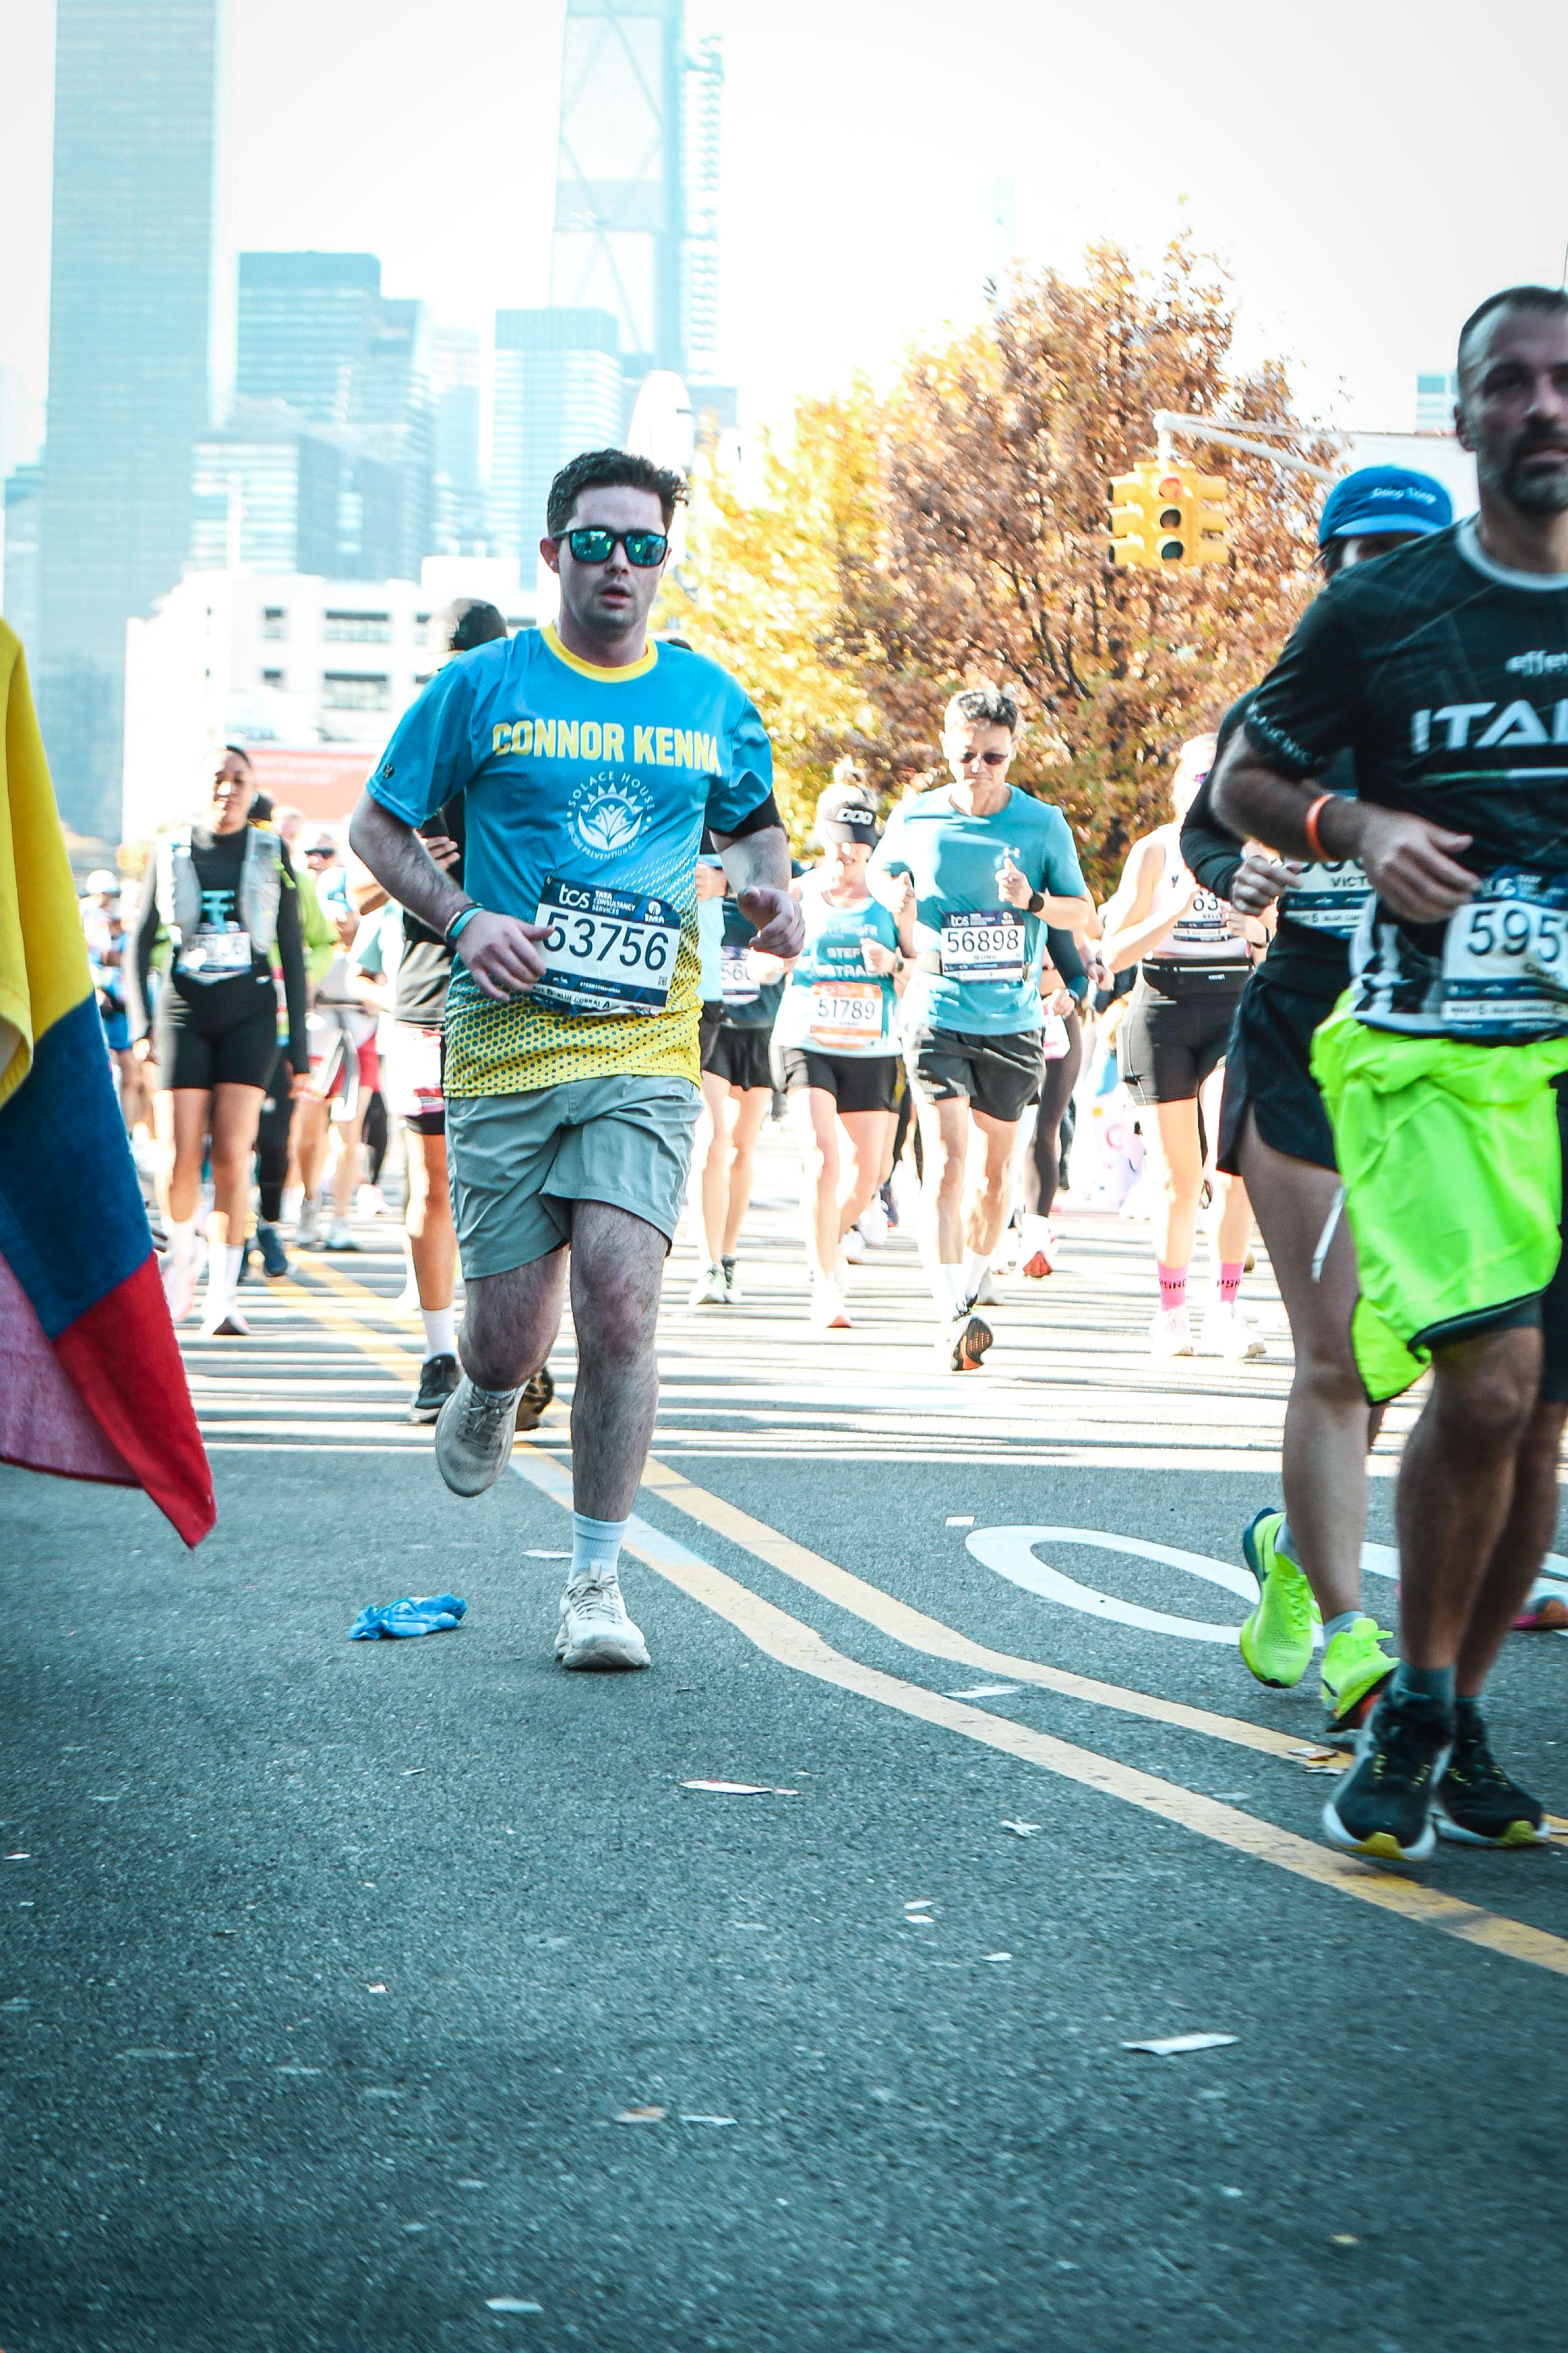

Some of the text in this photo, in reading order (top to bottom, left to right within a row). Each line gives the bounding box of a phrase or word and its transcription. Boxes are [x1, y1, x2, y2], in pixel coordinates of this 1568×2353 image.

[492, 718, 722, 776] CONNOR KENNA
[568, 771, 655, 810] SOLACE HOUSE
[1331, 876, 1369, 888] VICT
[559, 884, 590, 909] tcs
[593, 898, 636, 912] CONSULTANCY
[595, 890, 612, 901] TATA
[950, 914, 969, 927] tcs
[542, 912, 669, 971] 53756
[948, 929, 1019, 952] 56898
[1467, 909, 1568, 962] 595
[602, 1000, 610, 1009] A
[819, 998, 875, 1019] 51789
